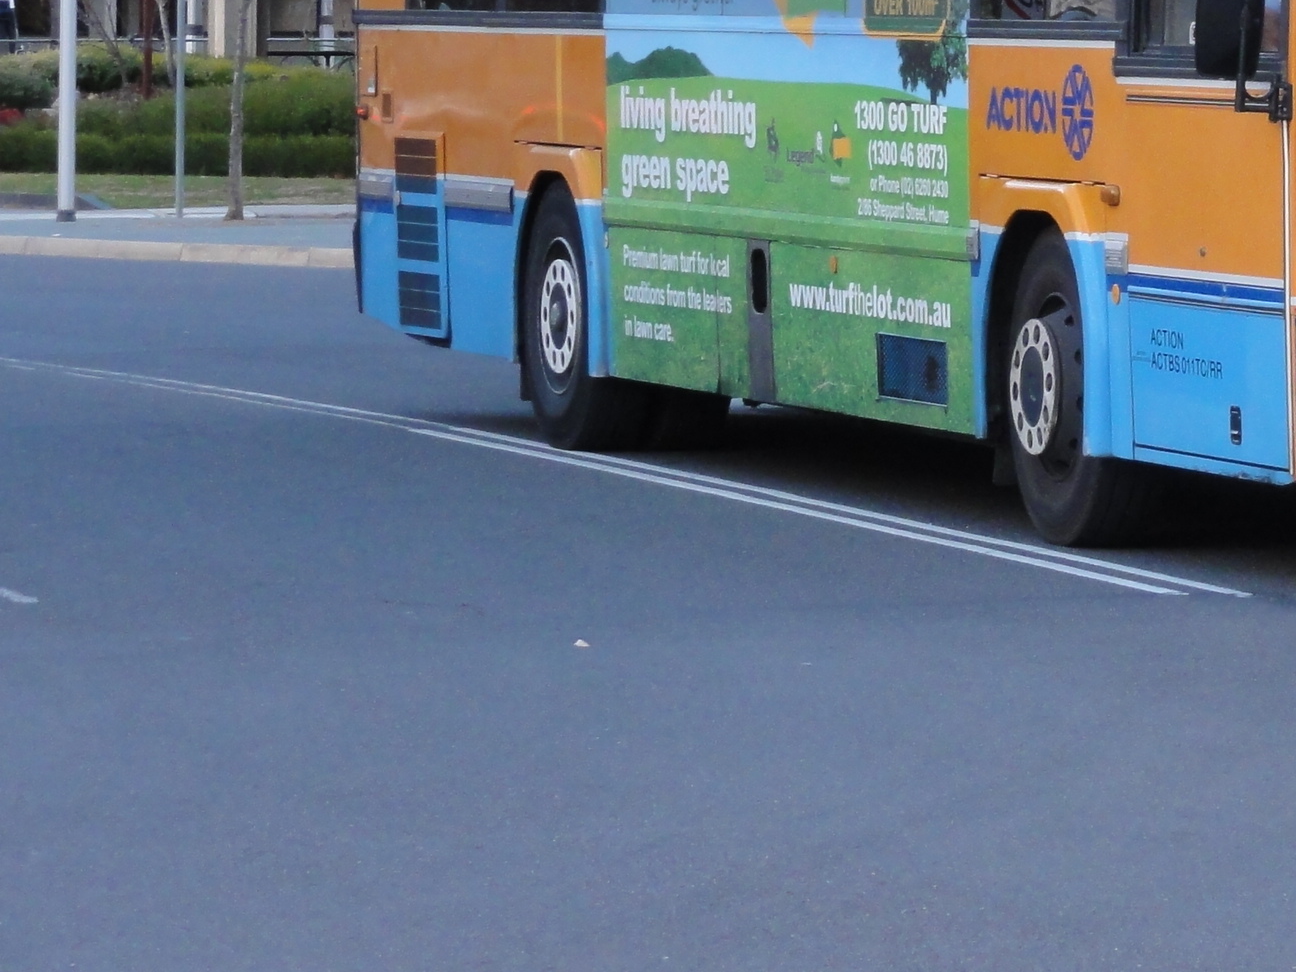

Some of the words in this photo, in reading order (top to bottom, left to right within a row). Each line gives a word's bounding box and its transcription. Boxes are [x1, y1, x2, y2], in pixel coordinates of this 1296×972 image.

[620, 85, 666, 143] living
[670, 87, 757, 149] breathing
[854, 100, 885, 131] 1300
[888, 102, 908, 133] GO
[911, 103, 948, 135] TURF
[986, 86, 1057, 135] ACTION
[868, 139, 898, 171] (1300
[900, 141, 914, 168] 46
[916, 142, 948, 177] 8873)
[621, 154, 672, 199] green
[675, 157, 730, 203] space
[870, 177, 878, 192] or
[878, 174, 900, 194] Phone
[929, 203, 950, 225] Hume
[623, 243, 659, 270] Premium
[660, 247, 679, 272] lawn
[680, 250, 696, 273] turf
[697, 251, 709, 275] for
[623, 280, 666, 306] conditions
[666, 283, 687, 308] from
[687, 286, 702, 310] the
[788, 280, 952, 329] www.turfthelot.com.au
[624, 314, 633, 337] in
[634, 315, 653, 339] lawn
[1150, 328, 1184, 350] ACTION
